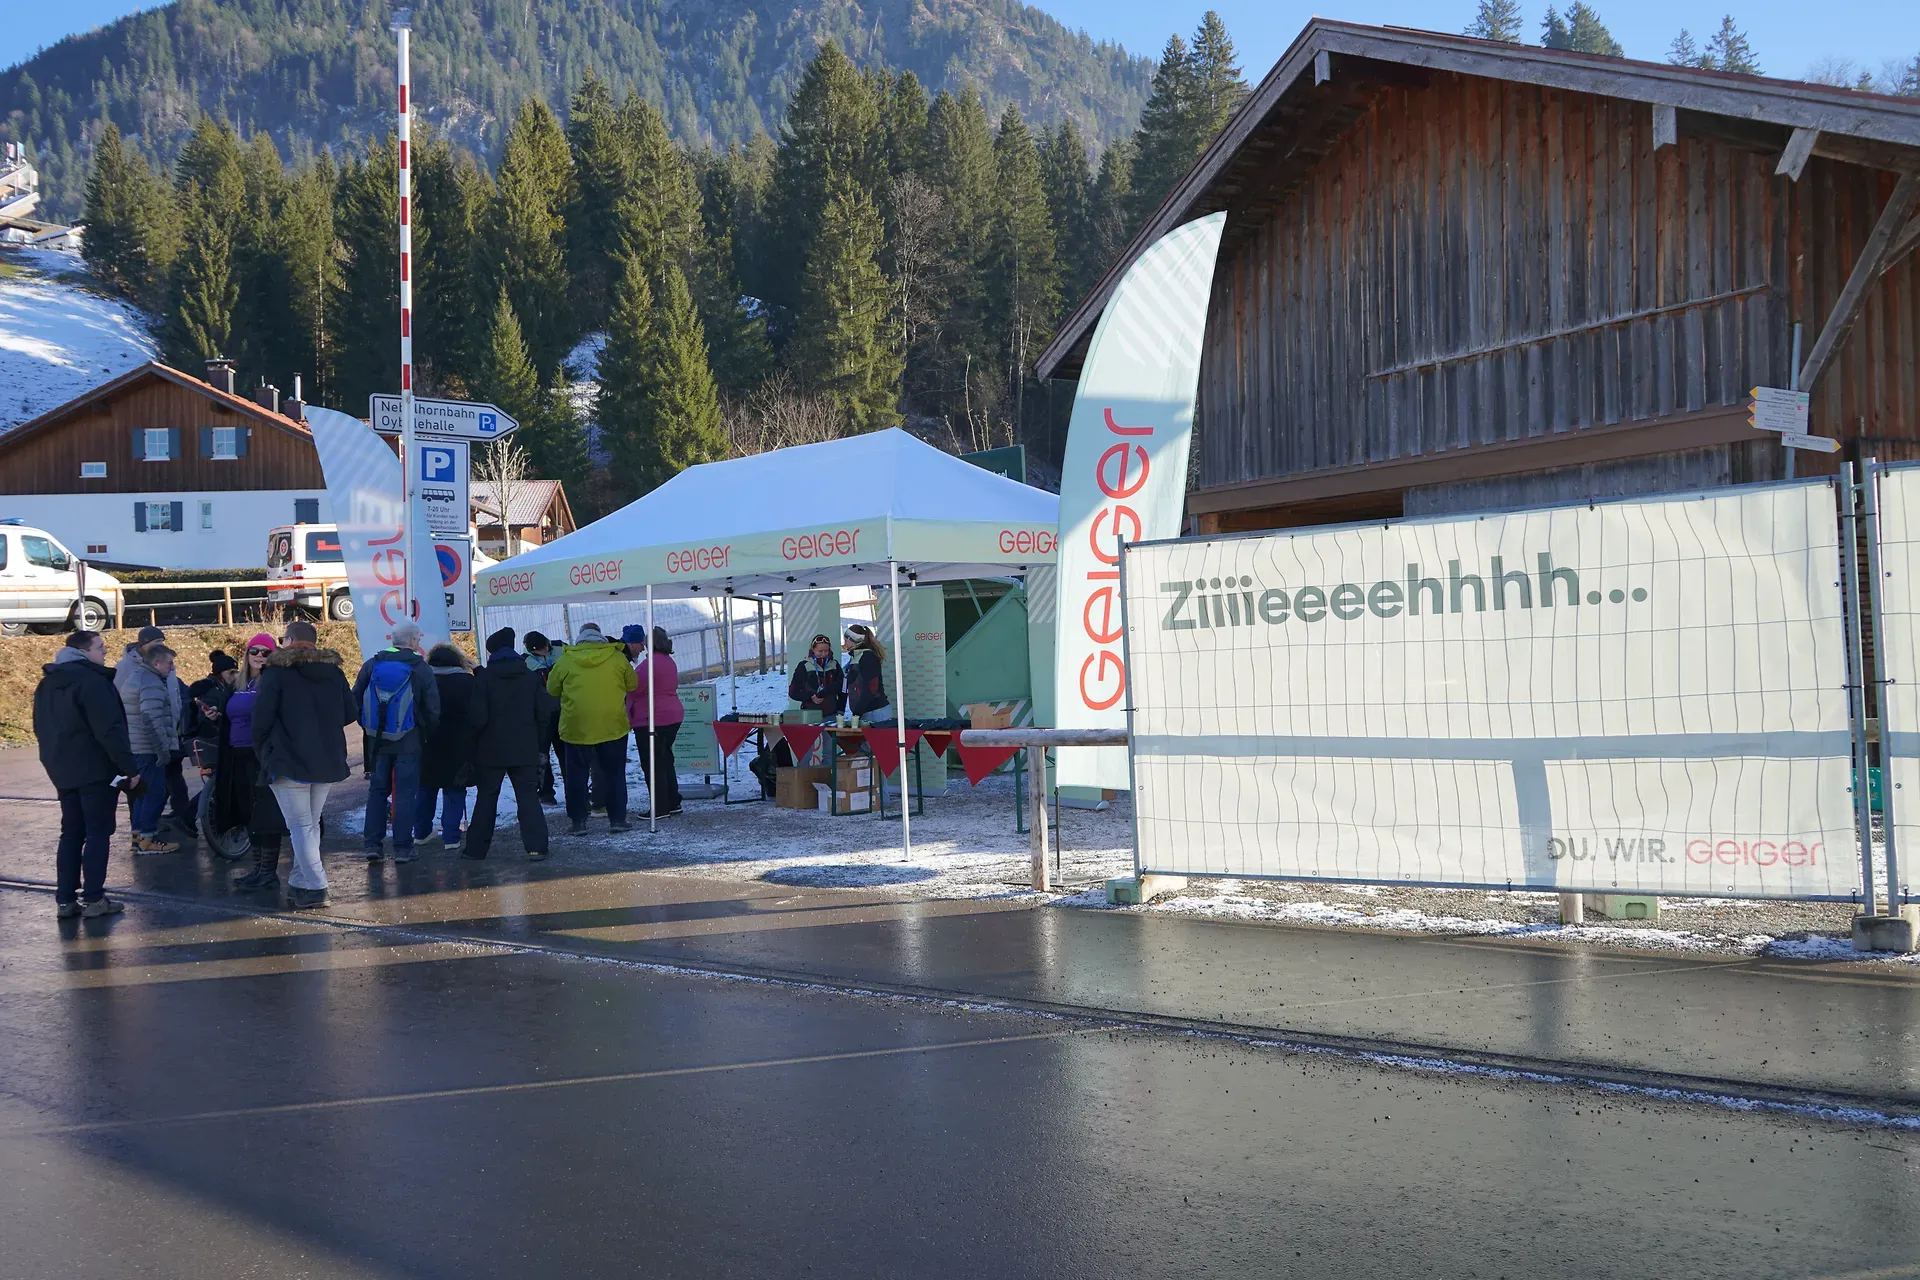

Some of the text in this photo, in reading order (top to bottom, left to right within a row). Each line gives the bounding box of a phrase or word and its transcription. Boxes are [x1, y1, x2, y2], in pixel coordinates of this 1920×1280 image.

[381, 401, 475, 419] Nelhornbahn
[381, 415, 455, 431] Oylehalle
[1160, 552, 1648, 631] Ziiiieeeehhhh...
[1604, 837, 1676, 864] WIR.
